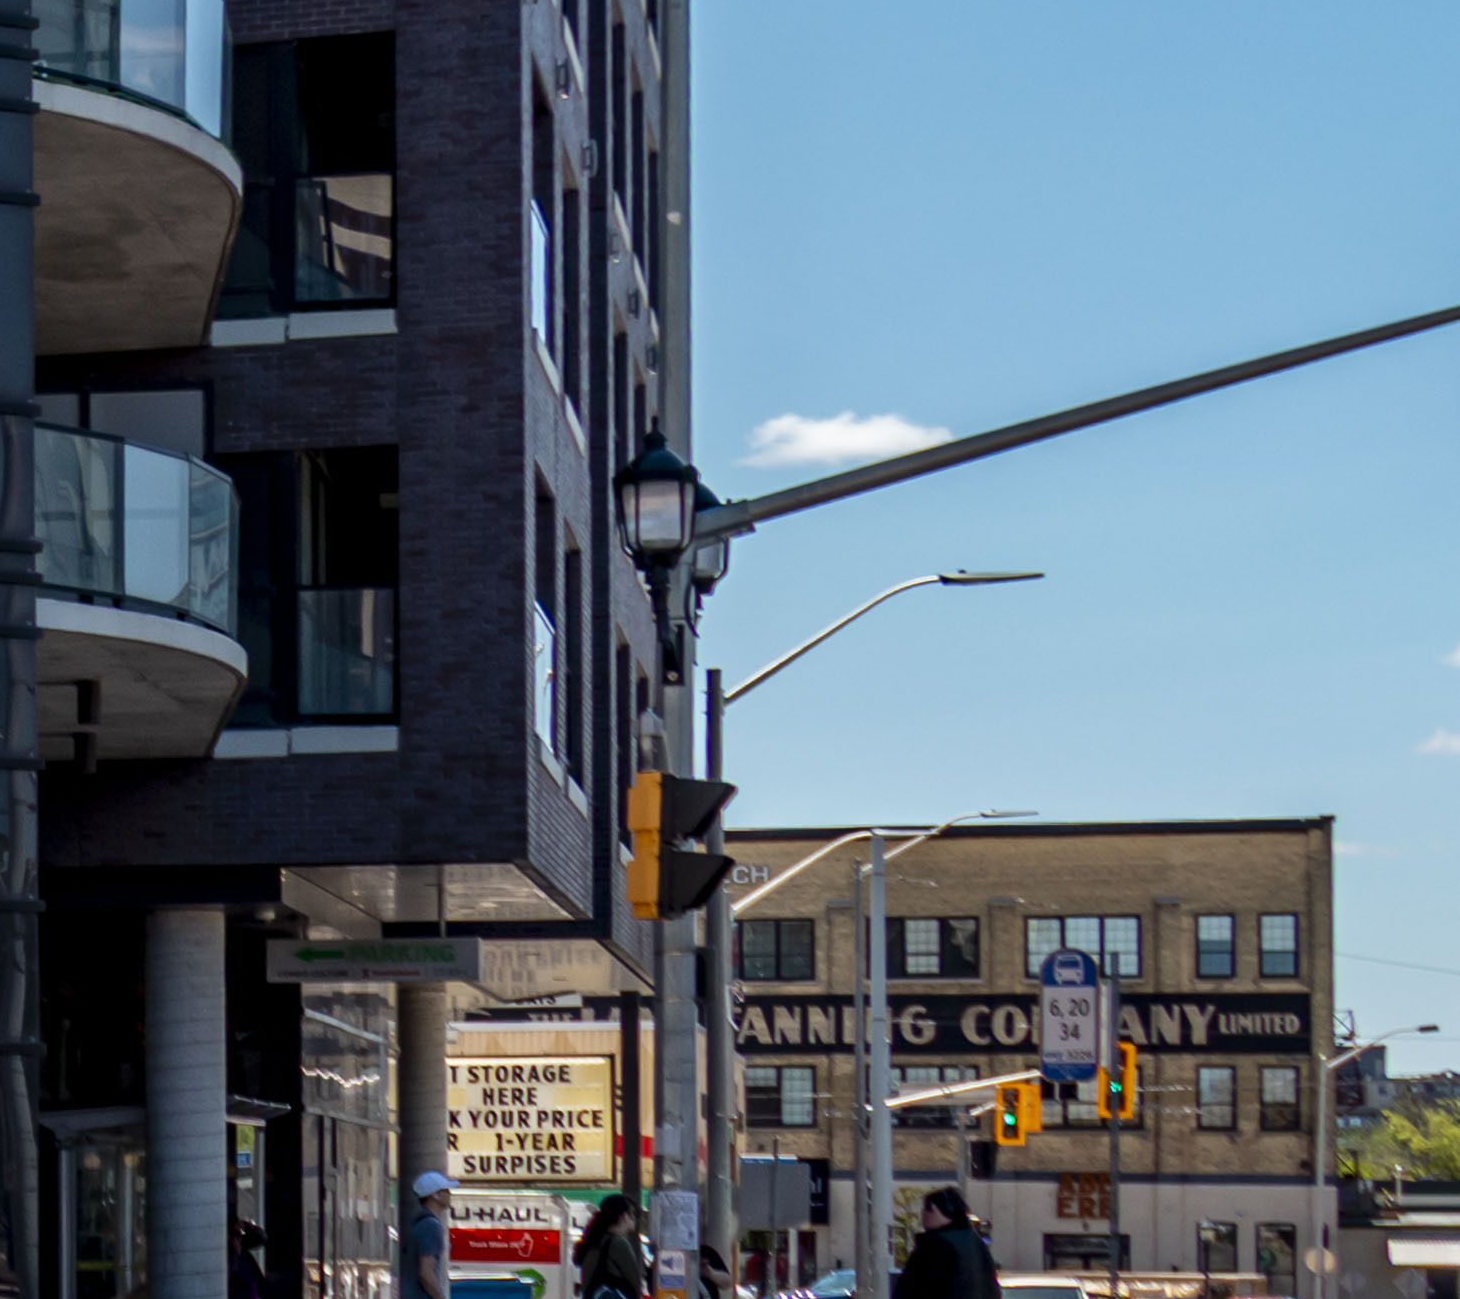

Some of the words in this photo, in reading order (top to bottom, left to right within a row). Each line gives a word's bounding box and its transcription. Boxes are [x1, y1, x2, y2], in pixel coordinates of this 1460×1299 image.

[349, 943, 456, 963] PARKING
[1069, 998, 1090, 1017] 20
[960, 1004, 1216, 1046] COANY
[1219, 1012, 1301, 1035] LIMITED
[1059, 1022, 1081, 1042] 34
[467, 1065, 571, 1084] STORAGE
[482, 1087, 538, 1107] HERE
[469, 1110, 530, 1129] YOUR
[537, 1110, 604, 1129] PRICE
[495, 1132, 576, 1152] 1-YEAR
[463, 1155, 577, 1175] SURPISES
